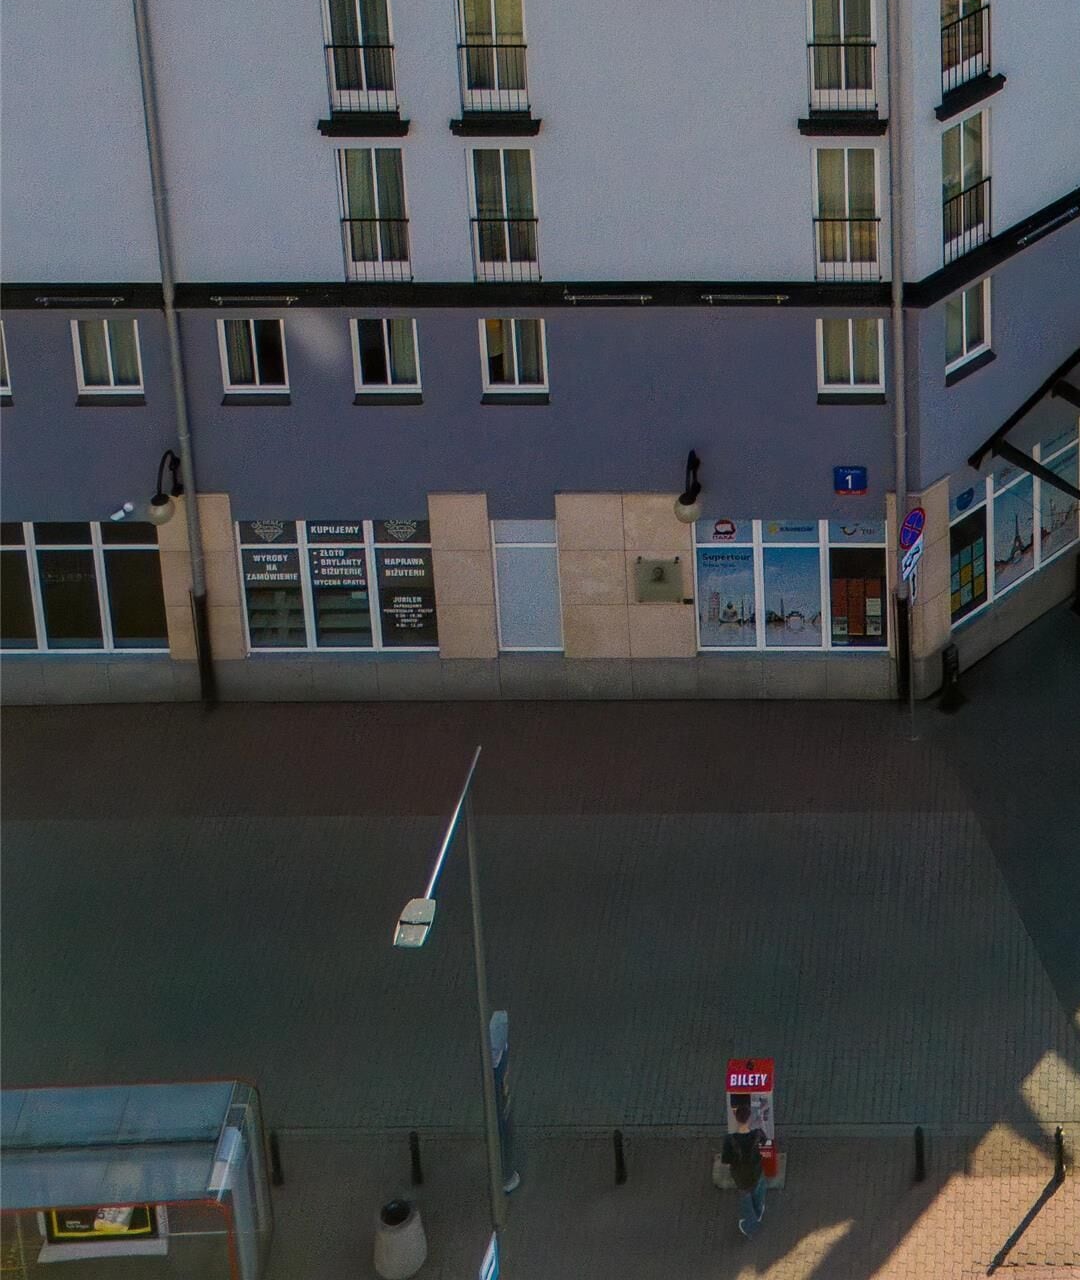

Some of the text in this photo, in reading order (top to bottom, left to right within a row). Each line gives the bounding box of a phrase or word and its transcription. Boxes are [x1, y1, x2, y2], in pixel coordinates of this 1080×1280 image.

[845, 474, 852, 489] 1
[310, 525, 360, 534] KUPUJEMY
[253, 554, 288, 562] WYROBY
[320, 558, 362, 566] BRYLANTY
[384, 558, 425, 566] NAPRAWA
[703, 553, 752, 562] Supertour
[266, 563, 278, 571] NA
[246, 572, 299, 581] ZAMÓWIENIE
[730, 1074, 768, 1086] BILETY
